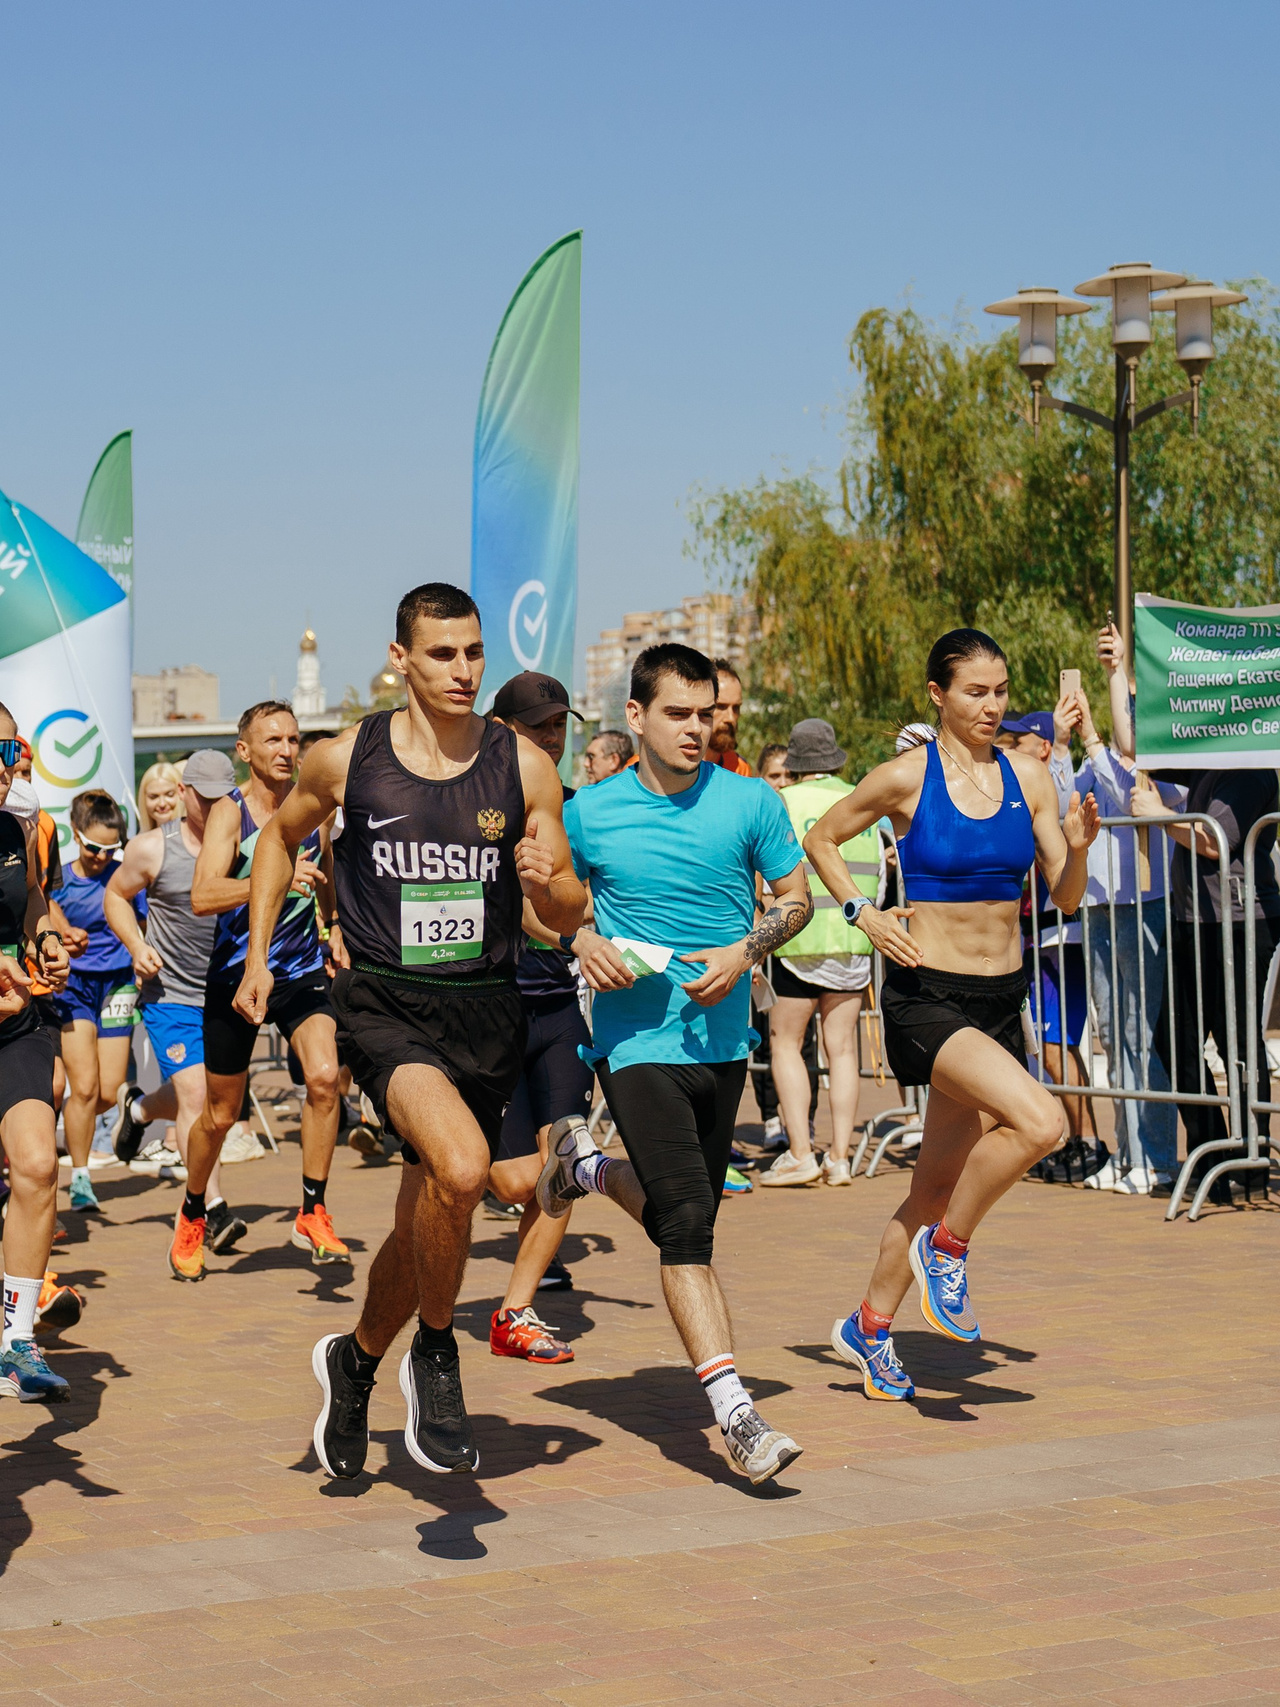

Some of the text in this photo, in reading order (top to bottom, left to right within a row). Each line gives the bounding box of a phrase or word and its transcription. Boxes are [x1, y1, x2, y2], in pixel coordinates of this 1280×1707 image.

[1175, 621, 1247, 640] Команда
[1249, 622, 1272, 637] ТП
[1168, 645, 1280, 662] Желает побед
[1167, 671, 1233, 688] Лещенко
[1170, 697, 1226, 715] Митину
[1171, 718, 1280, 739] Киктенко Све
[372, 840, 500, 882] RUSSIA
[413, 918, 475, 943] 1323
